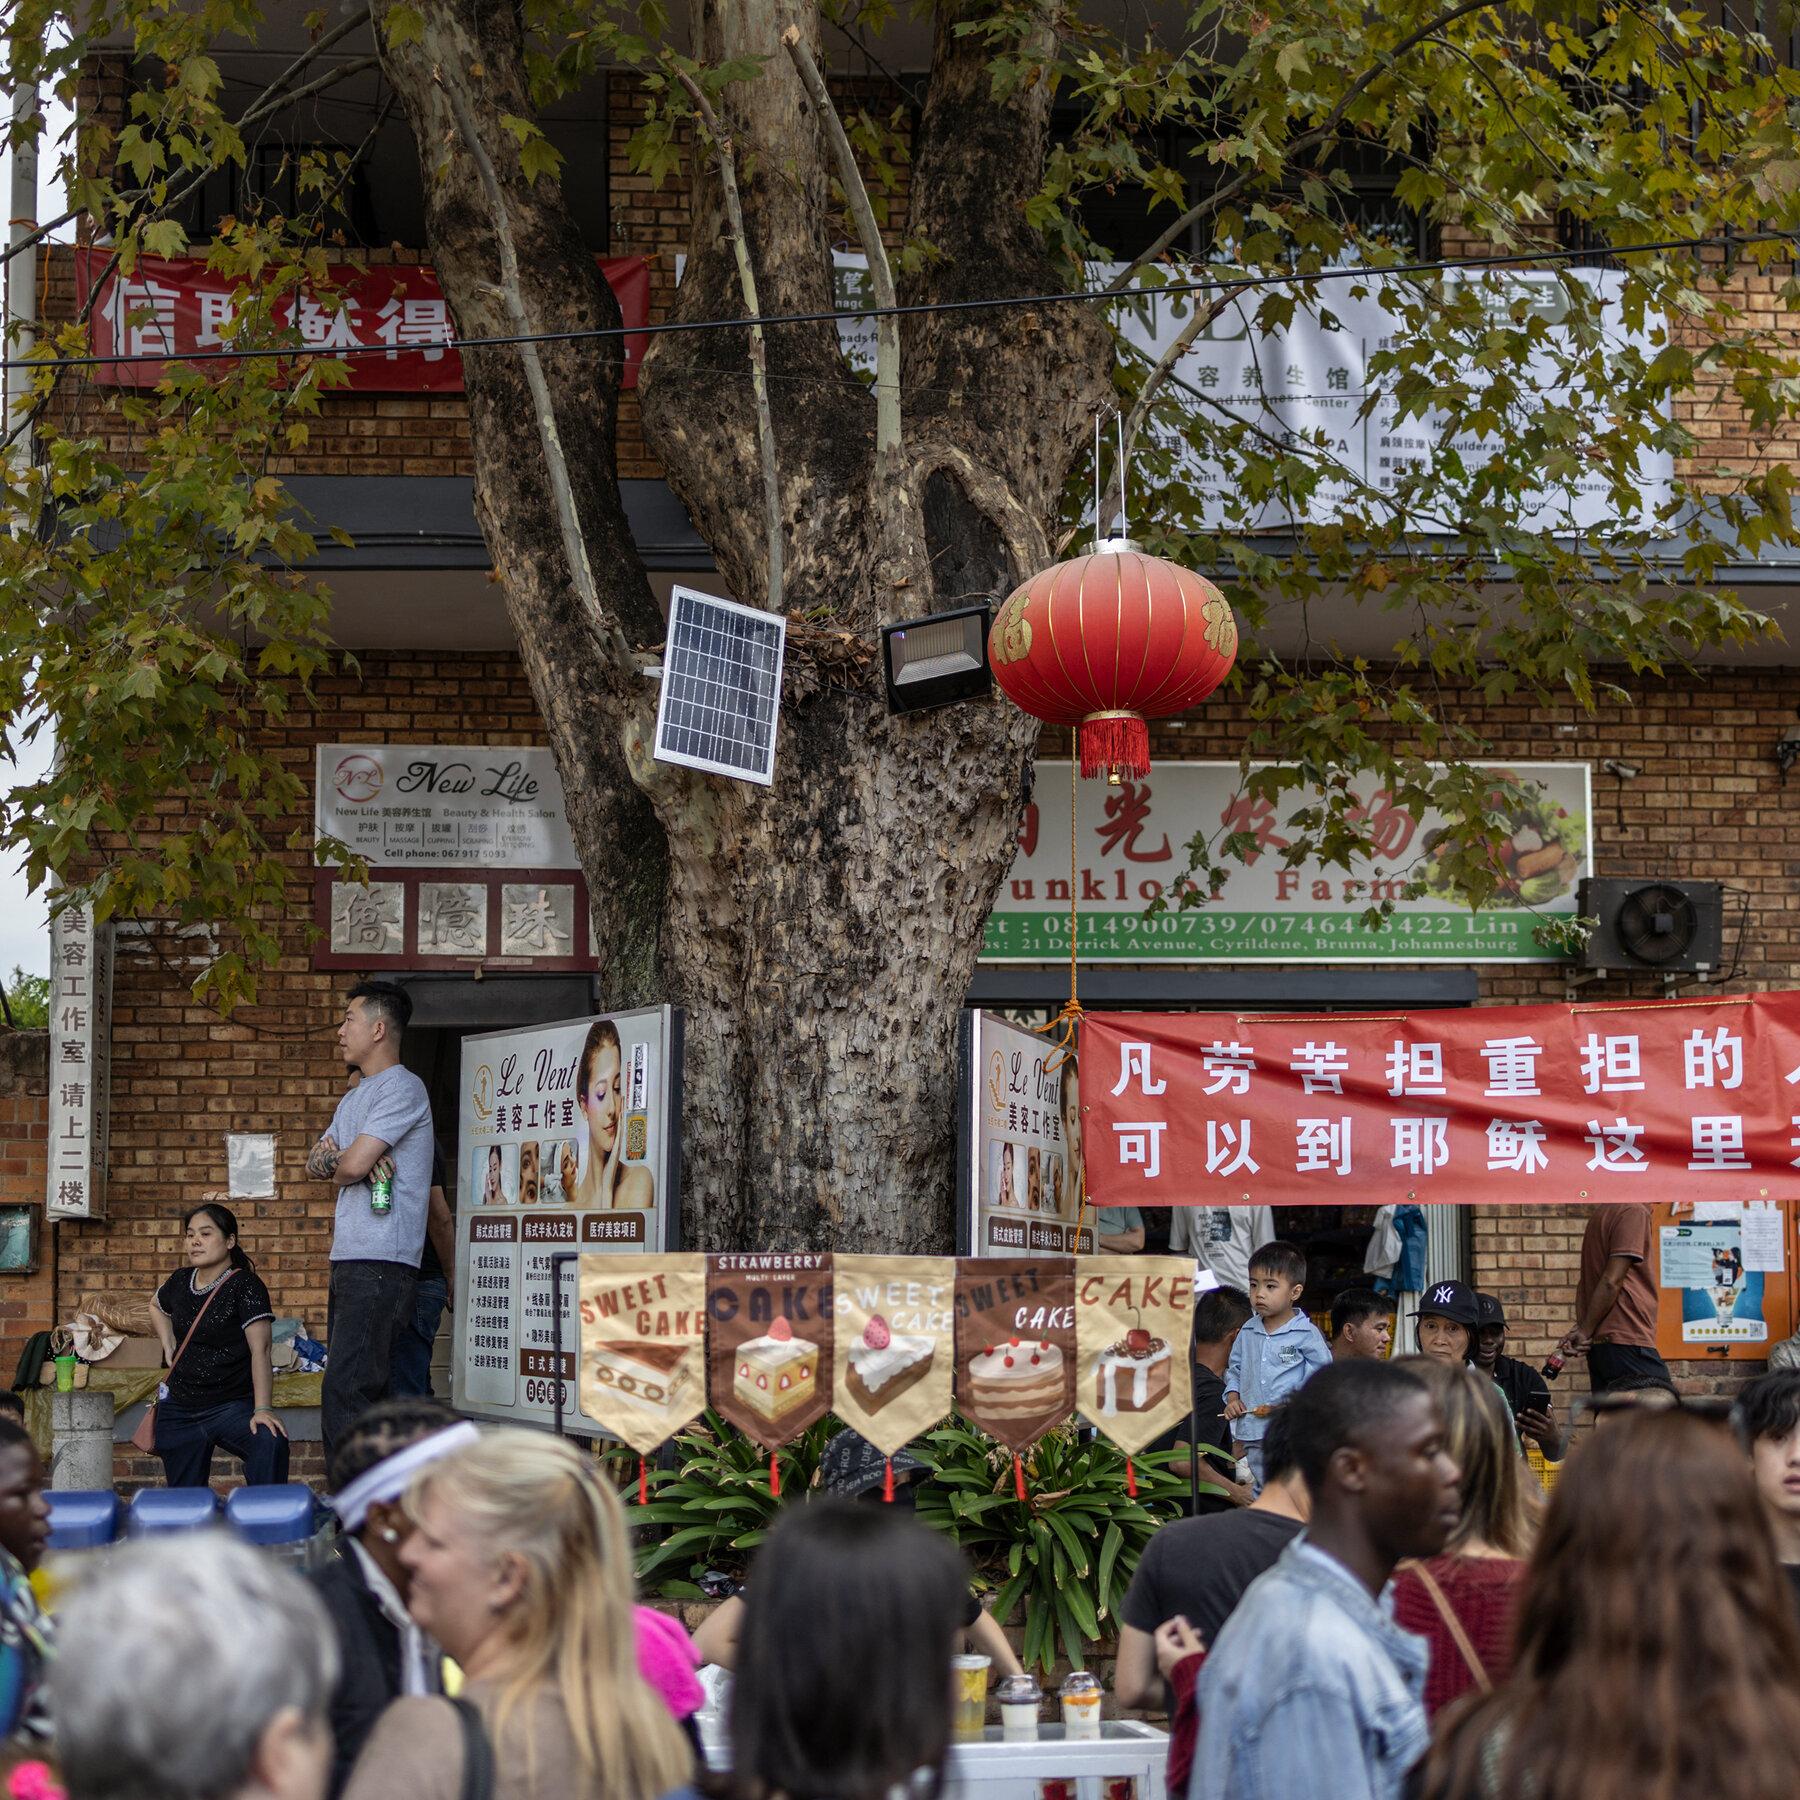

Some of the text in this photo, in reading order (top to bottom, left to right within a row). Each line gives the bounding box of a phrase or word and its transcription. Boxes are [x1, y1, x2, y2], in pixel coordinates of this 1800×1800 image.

[1433, 439, 1488, 452] Soulder
[396, 761, 539, 805] New Life
[335, 807, 556, 819] New Life 美容养生馆 Beauty & Health Salon
[355, 836, 380, 844] BEAUTY
[384, 849, 507, 860] Cell phone: 067 917 5093
[1465, 916, 1518, 935] Lin
[1022, 939, 1040, 950] 21
[1048, 938, 1121, 950] Derrick
[1127, 938, 1203, 952] Avenue,
[1210, 938, 1307, 953] Cyrildene,
[1315, 938, 1384, 952] Bruma,
[1391, 938, 1518, 953] Johannesburg
[496, 1053, 525, 1097] Le
[534, 1048, 578, 1093] Vent
[1008, 1051, 1059, 1105] Le Vent
[1110, 1026, 1800, 1097] 凡劳苦担重担的
[496, 1098, 575, 1134] 美容工作室
[1008, 1101, 1060, 1142] 美容工作室
[59, 1083, 86, 1206] 请上二楼
[1111, 1115, 1800, 1179] 可以到耶稣这里
[589, 1220, 637, 1239] 医疗美容项目
[718, 1254, 823, 1271] STRAWBERRY
[580, 1274, 667, 1325] SWEET
[707, 1284, 833, 1323] CAKE
[836, 1281, 945, 1316] SWEET
[956, 1268, 1041, 1318] SWEET
[1080, 1276, 1194, 1311] CAKE
[1433, 1286, 1453, 1304] NY
[635, 1310, 705, 1337] CAKE
[891, 1310, 953, 1333] CAKE
[1014, 1305, 1074, 1330] CAKE
